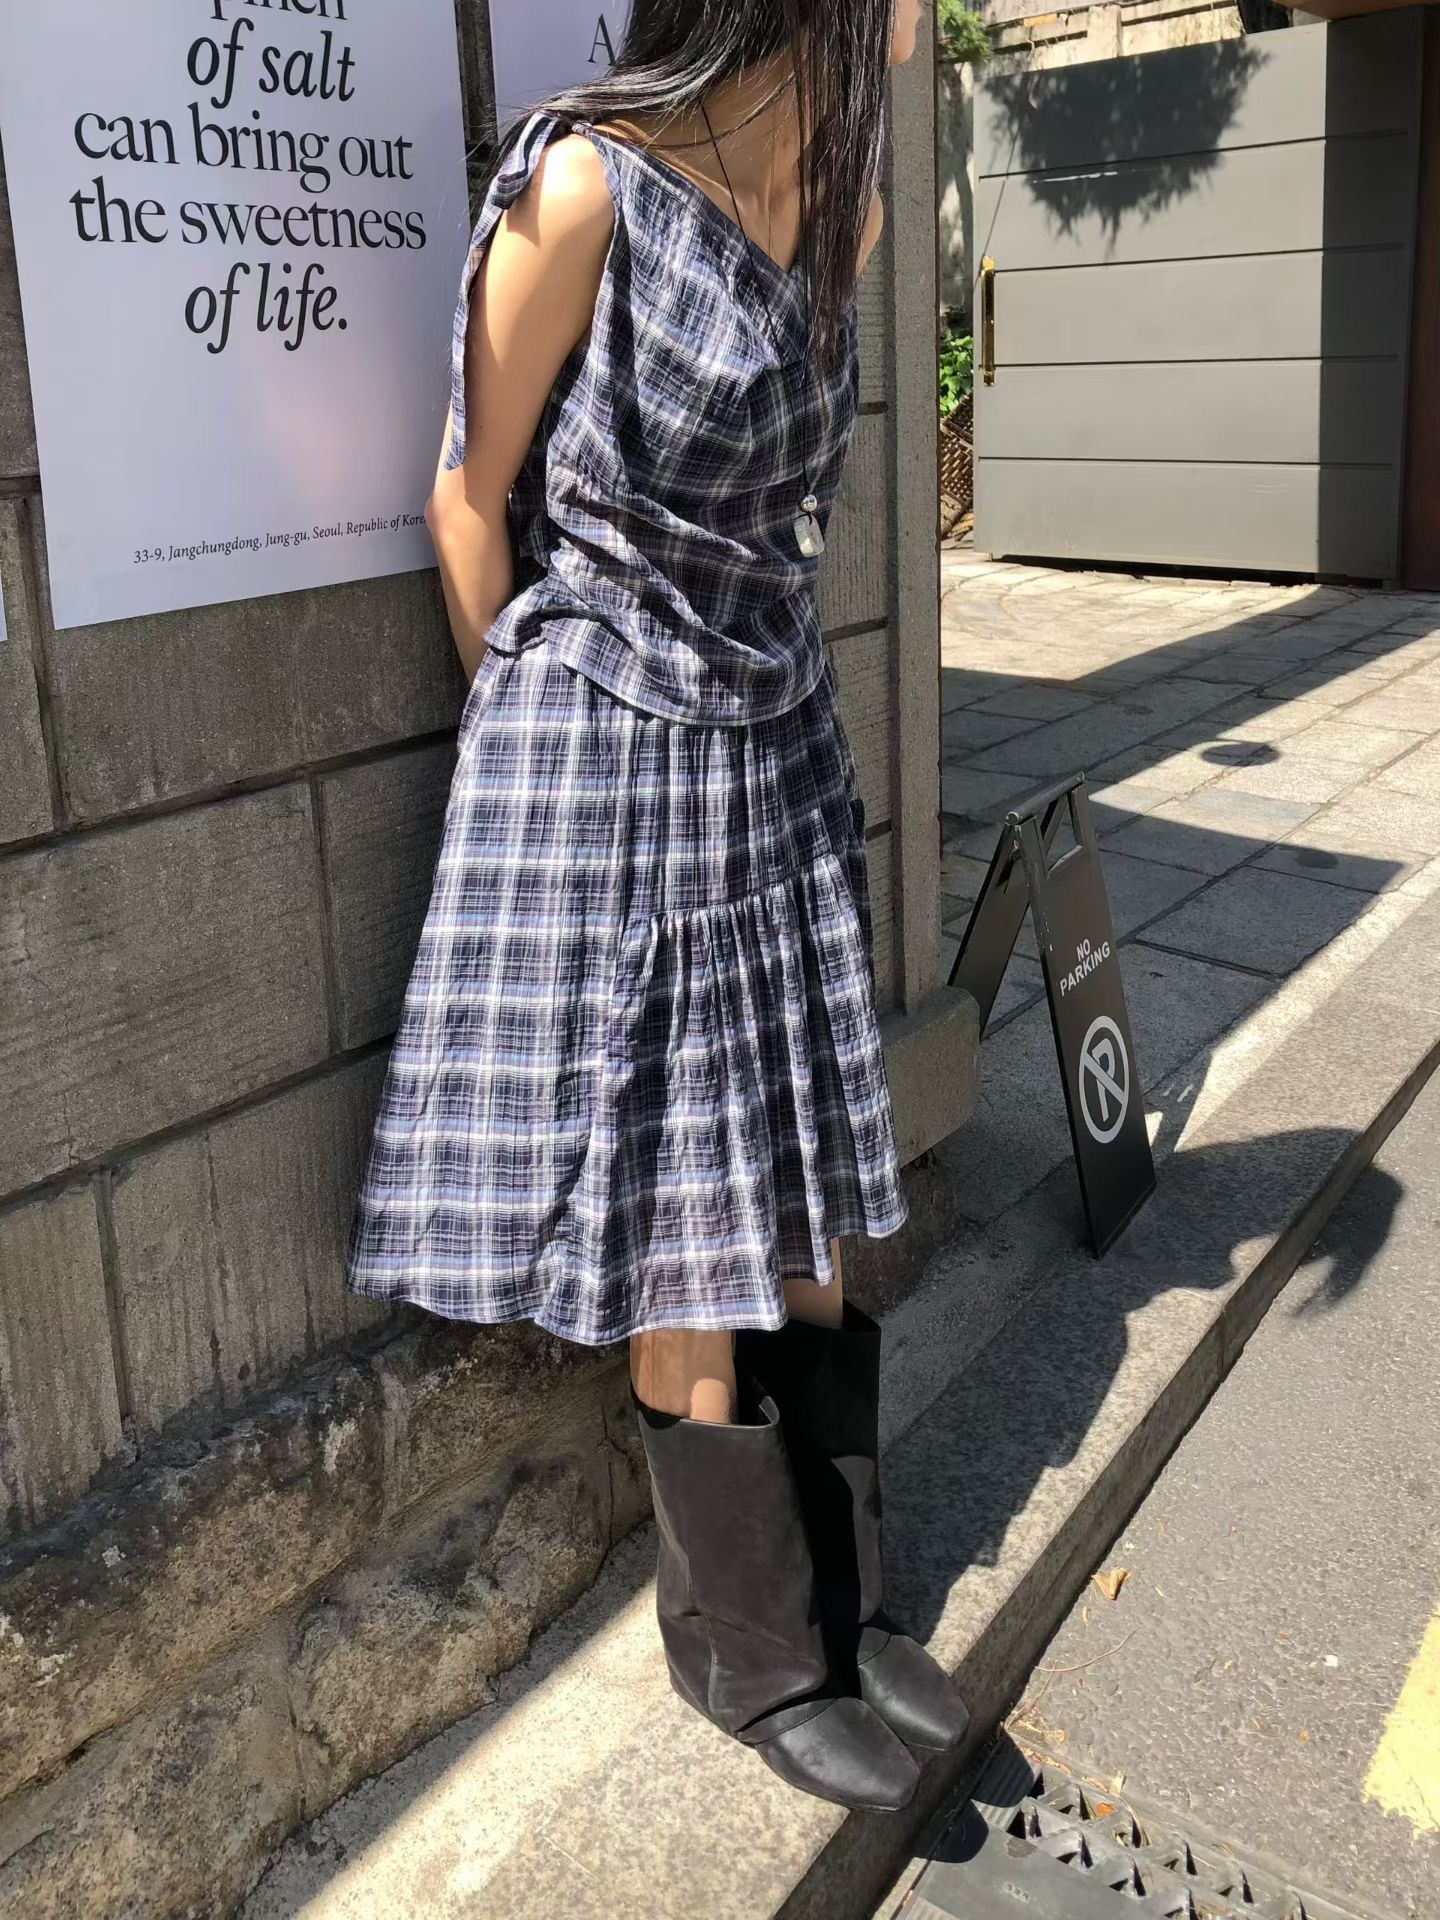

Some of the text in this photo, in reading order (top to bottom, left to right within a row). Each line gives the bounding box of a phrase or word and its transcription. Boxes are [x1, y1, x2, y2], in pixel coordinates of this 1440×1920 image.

[186, 17, 356, 110] of salt
[74, 101, 414, 194] can bring out
[69, 176, 427, 251] the sweetness
[184, 261, 348, 355] of life.
[133, 513, 427, 564] 33-9, Jangchungdong, Jung-gu, Seoul, Republic of Kore
[1059, 941, 1111, 997] PARKING
[1076, 938, 1091, 963] NO
